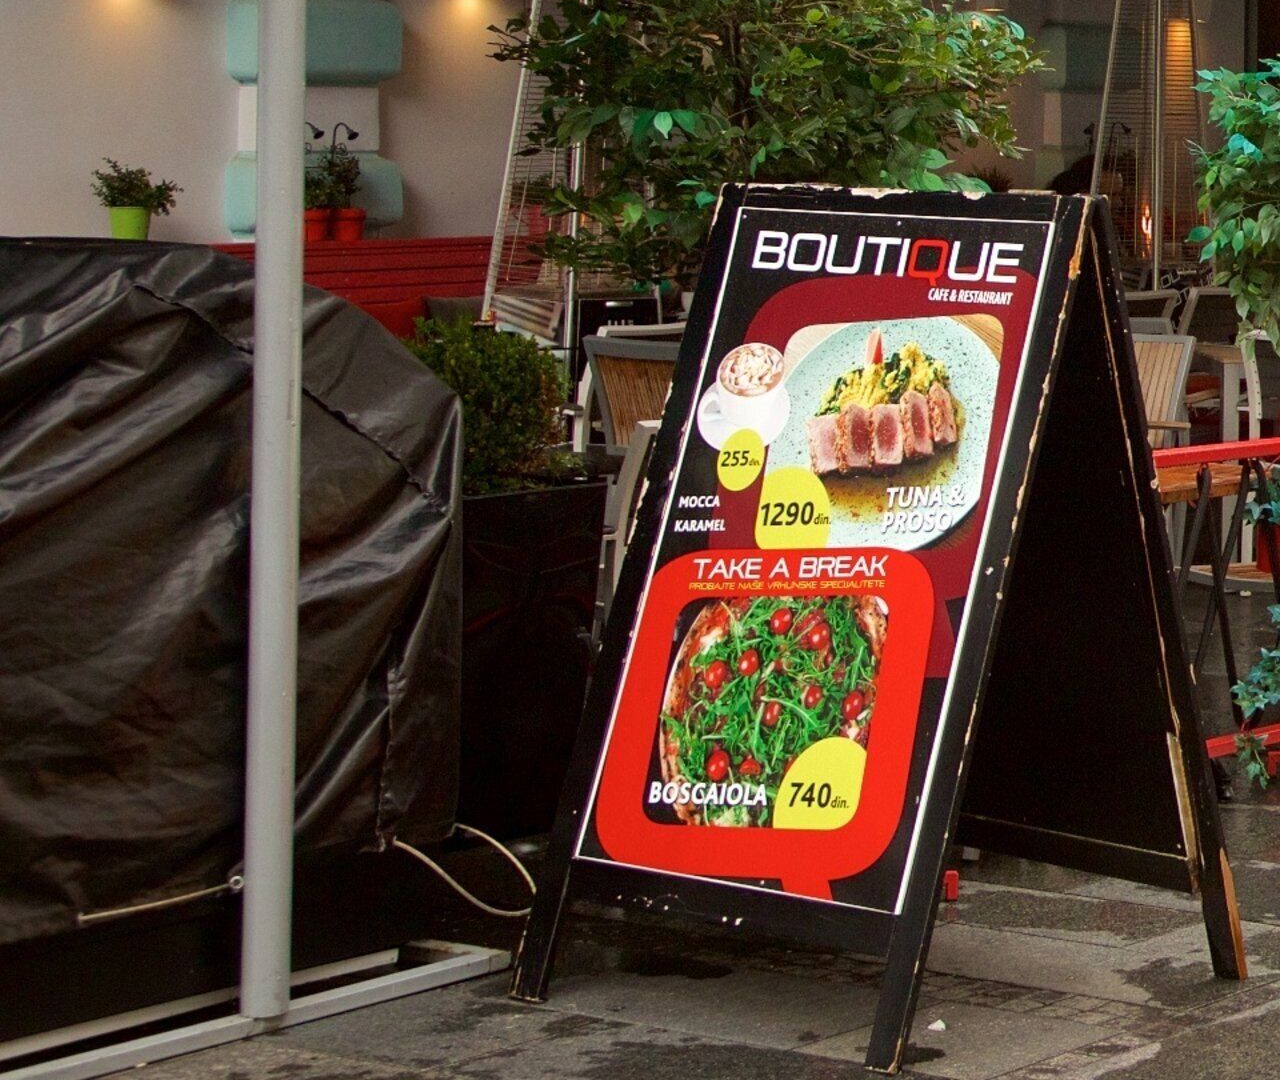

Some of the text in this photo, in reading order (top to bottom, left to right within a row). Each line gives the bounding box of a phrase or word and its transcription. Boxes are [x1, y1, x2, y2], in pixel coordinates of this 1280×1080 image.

[751, 230, 1025, 285] BOUTIQUE
[928, 287, 1014, 305] CAFE & RESTAURANT
[721, 450, 750, 467] 255
[678, 495, 720, 509] MOCCA
[886, 484, 965, 508] TUNA &
[674, 518, 726, 533] KARAMEL
[760, 501, 815, 527] 1290
[880, 510, 953, 535] PROSO
[693, 555, 889, 579] TAKE A BREAK
[688, 581, 735, 591] PROBAJTE
[738, 579, 764, 591] NAŠE
[767, 580, 817, 590] VRHUNSKE
[648, 781, 768, 806] BOSCAIOLA
[788, 781, 832, 808] 740
